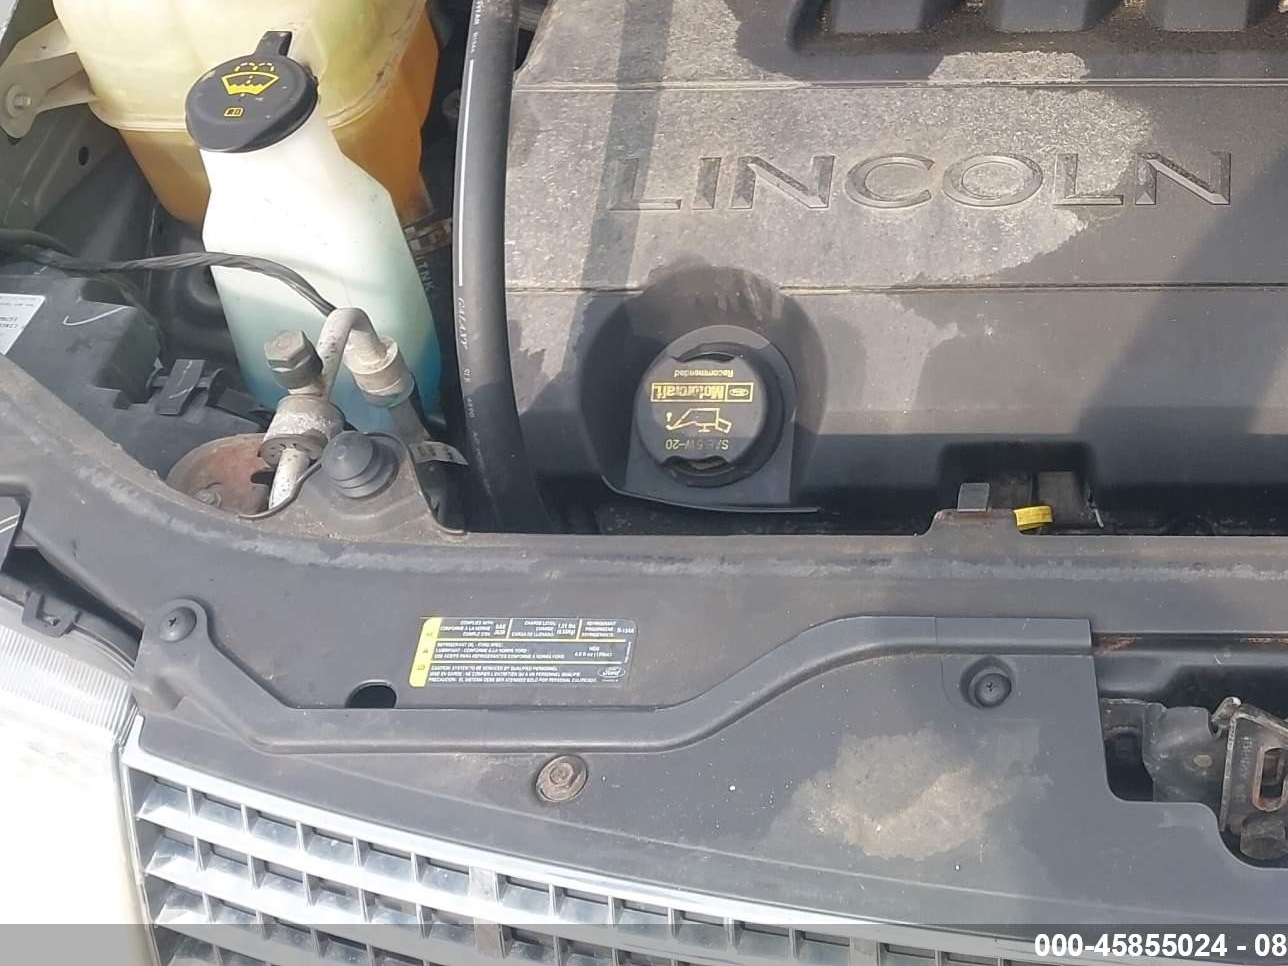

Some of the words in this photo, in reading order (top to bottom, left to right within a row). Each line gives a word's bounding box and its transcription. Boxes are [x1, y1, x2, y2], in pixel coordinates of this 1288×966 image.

[608, 150, 1233, 210] LINCOLN
[673, 369, 734, 378] Recommended
[654, 385, 724, 400] Motorcraft
